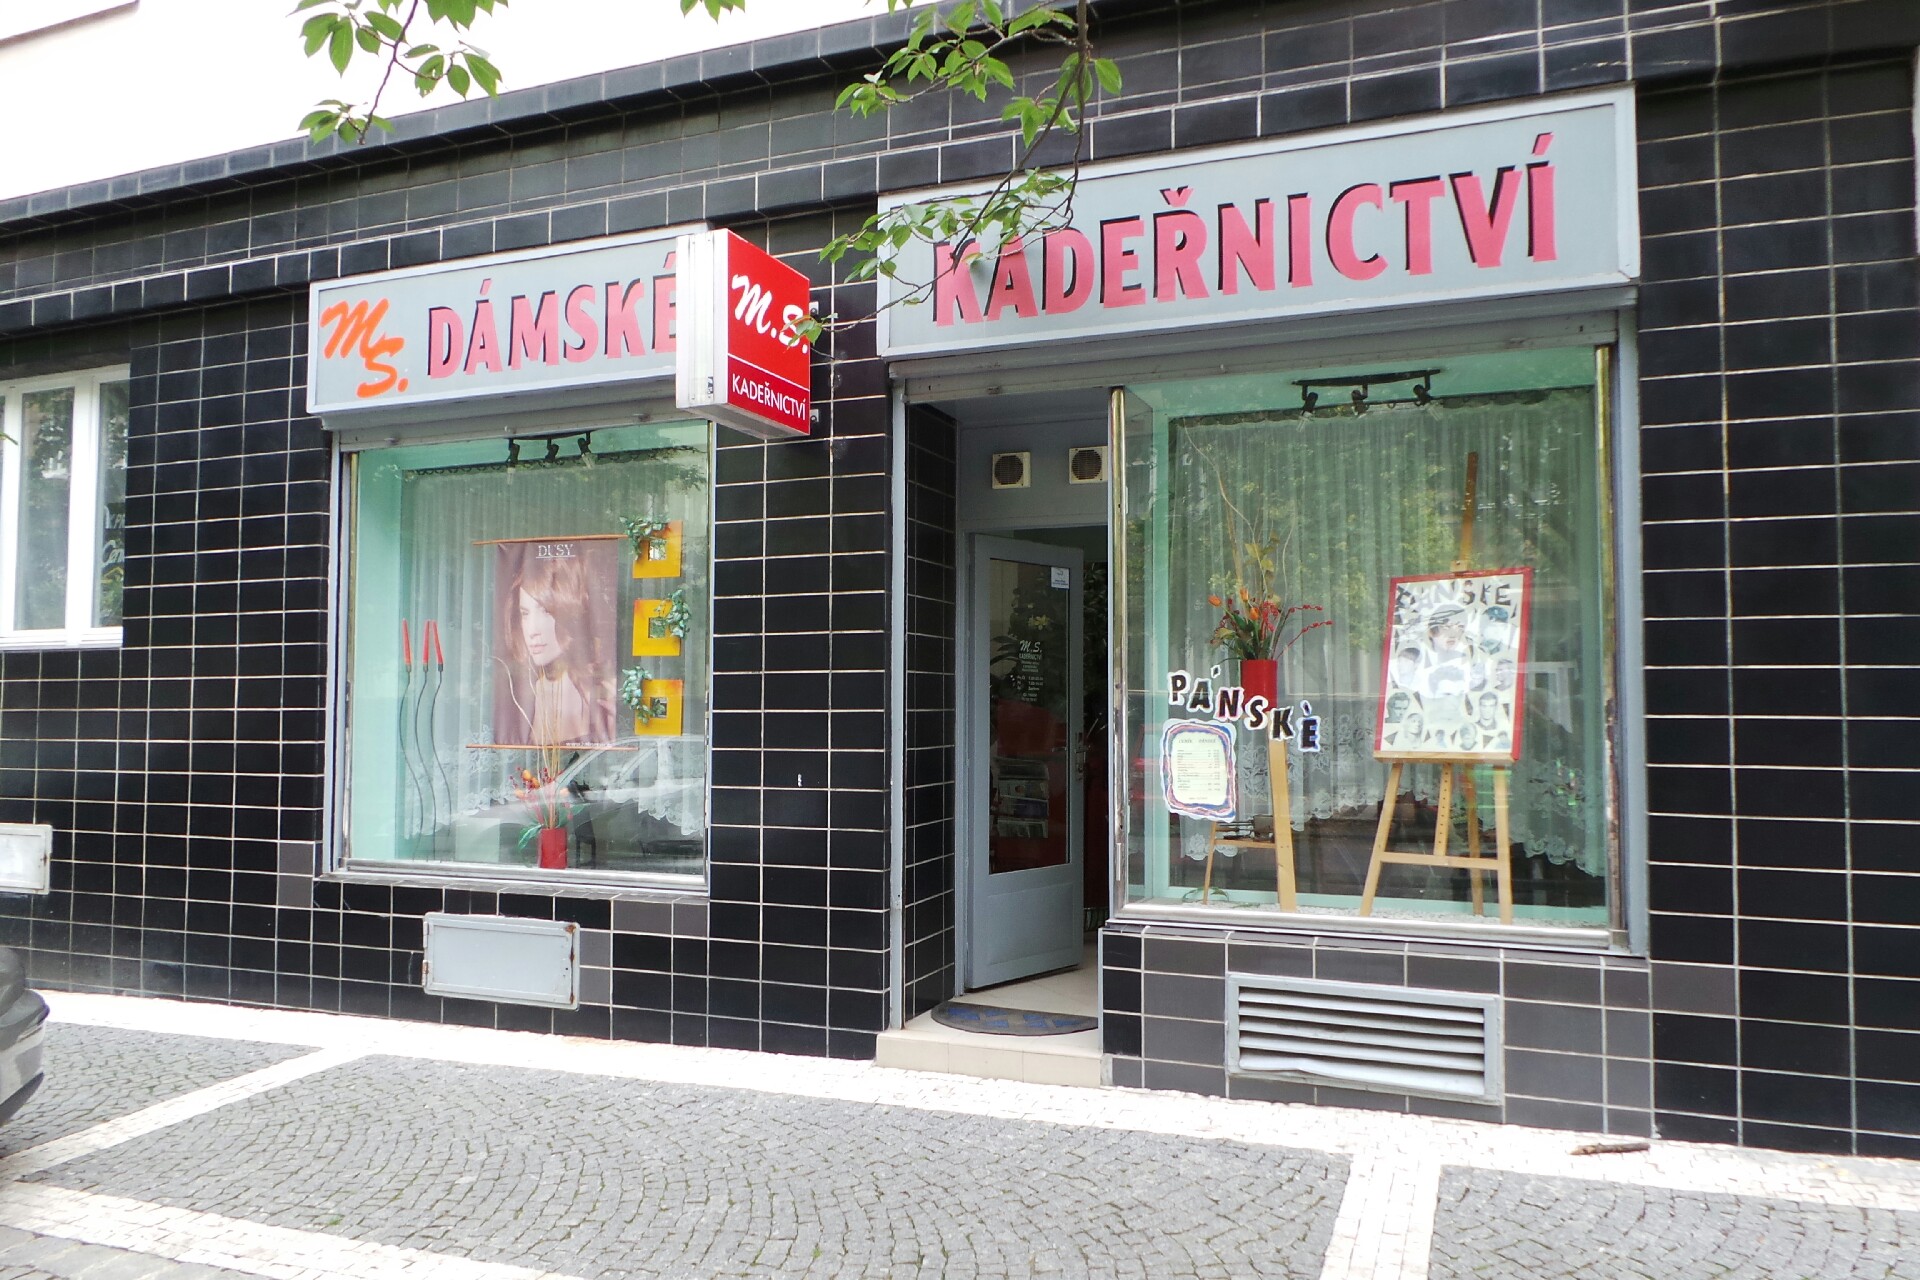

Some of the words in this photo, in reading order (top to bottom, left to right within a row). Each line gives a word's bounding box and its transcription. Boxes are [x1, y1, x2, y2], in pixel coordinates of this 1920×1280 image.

[933, 132, 1557, 327] KADEŘNICTVÍ
[427, 250, 677, 380] DÁMSKÉ
[732, 373, 806, 420] KADEŘNICTVÍ
